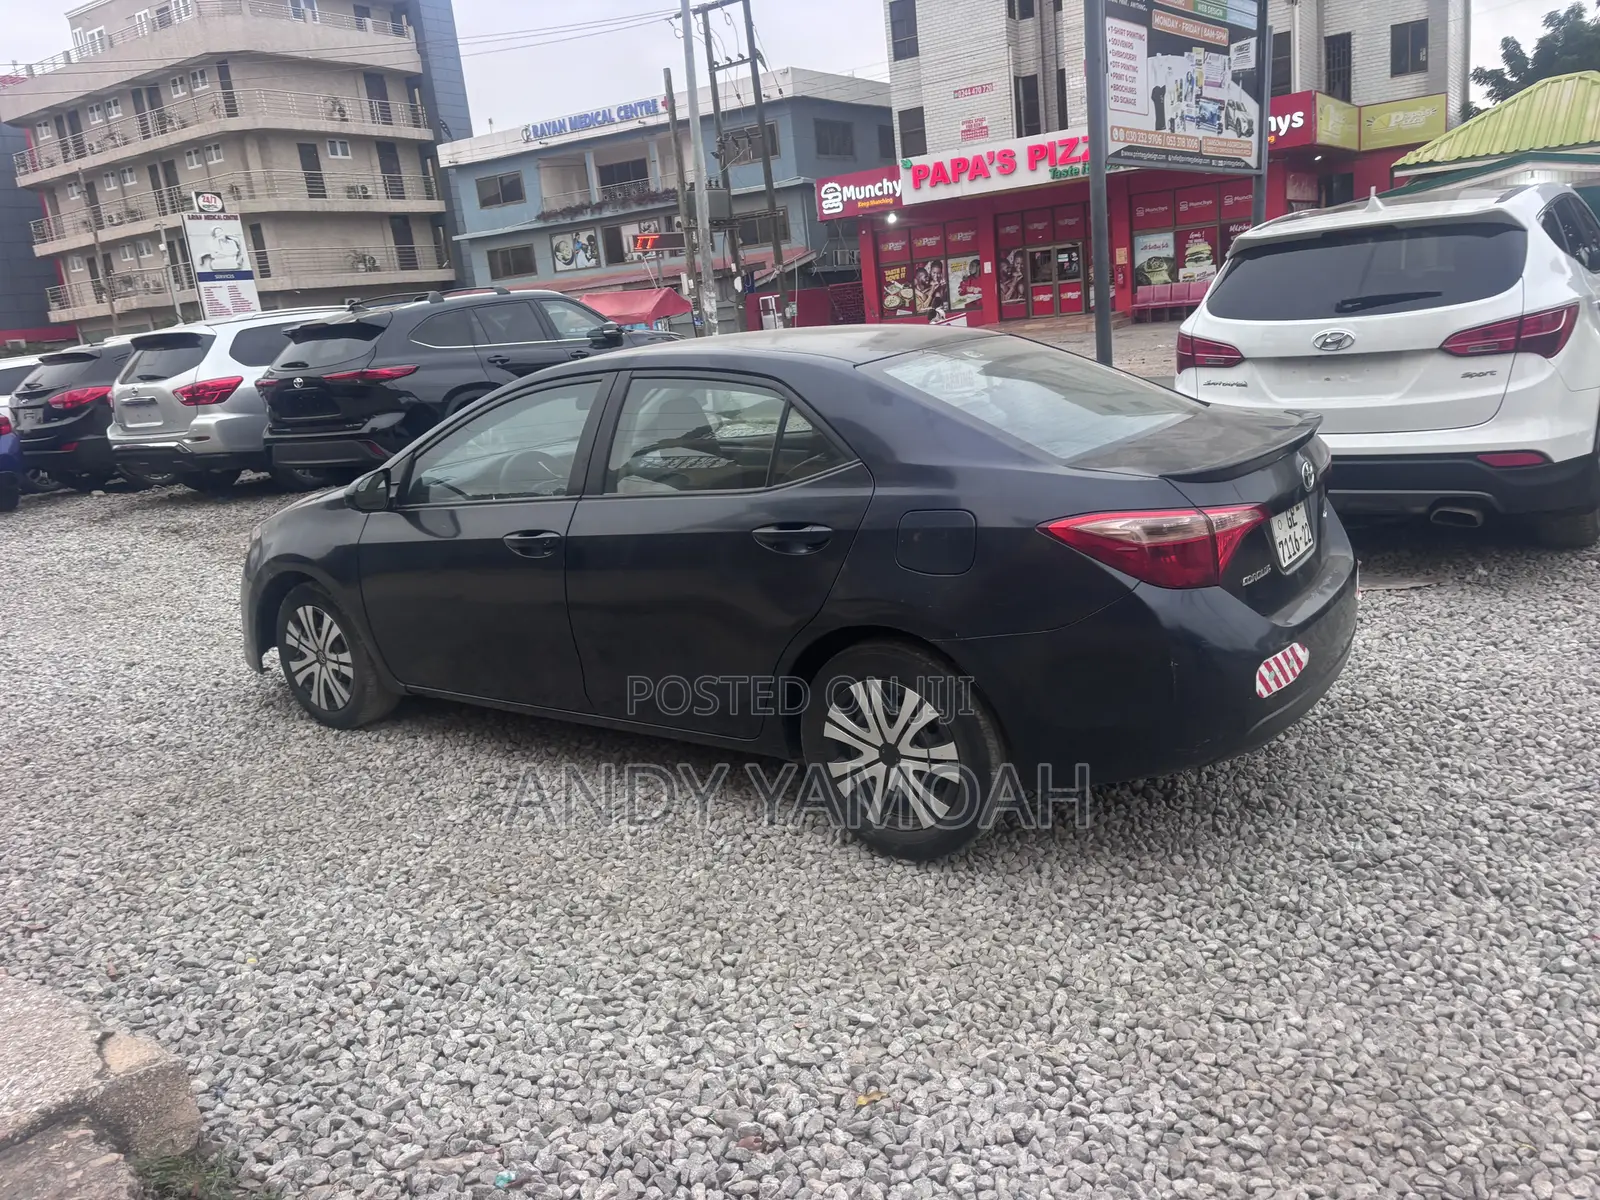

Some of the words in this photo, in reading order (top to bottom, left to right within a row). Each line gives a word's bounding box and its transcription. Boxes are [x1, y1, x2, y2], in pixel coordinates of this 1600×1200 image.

[1207, 6, 1223, 16] DESIGN
[1154, 14, 1178, 28] MONDAY
[1182, 22, 1200, 34] FRIDAY
[1120, 95, 1137, 106] SIGNAGE
[531, 118, 567, 139] RAYAN
[568, 108, 615, 131] MEDICAL
[616, 99, 659, 120] CENTRE
[911, 149, 1016, 190] PAPA'S
[1049, 166, 1080, 180] Taste
[842, 177, 902, 202] Munchy
[202, 195, 217, 205] 24/7
[1189, 199, 1213, 207] Munchys
[1234, 194, 1253, 202] Munch
[1145, 205, 1168, 213] Munchys
[884, 268, 900, 276] TASTE
[1460, 370, 1498, 379] Sport
[1285, 507, 1298, 530] GE
[1278, 522, 1312, 564] 7116-22
